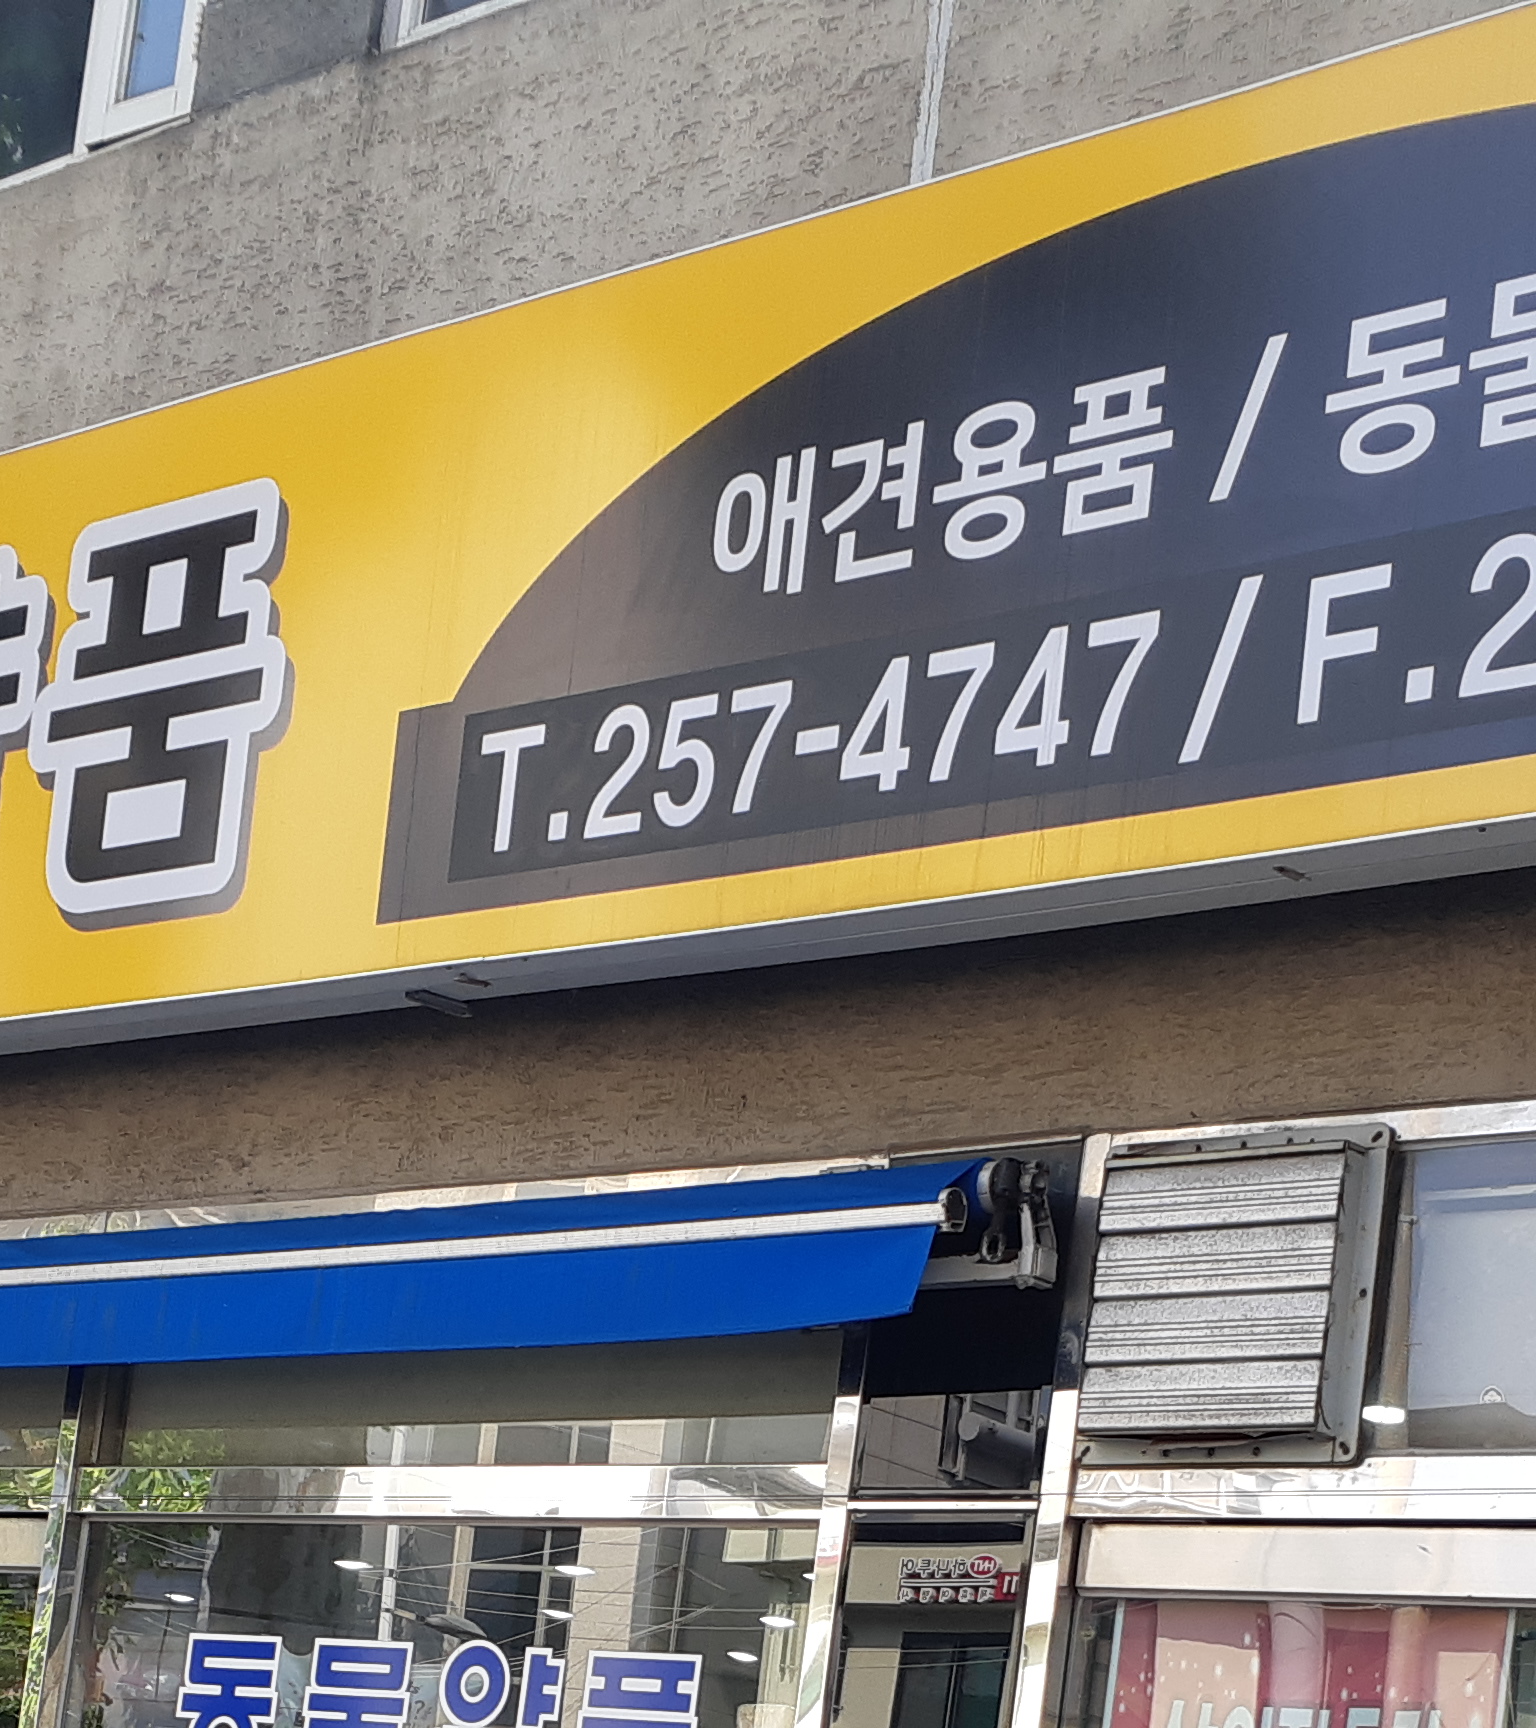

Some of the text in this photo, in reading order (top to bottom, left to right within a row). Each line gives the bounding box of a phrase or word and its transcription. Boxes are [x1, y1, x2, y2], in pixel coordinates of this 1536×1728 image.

[712, 365, 1173, 594] 애견용품
[1208, 332, 1288, 502] /
[480, 609, 1161, 852] T.257-4747
[1178, 574, 1262, 763] /
